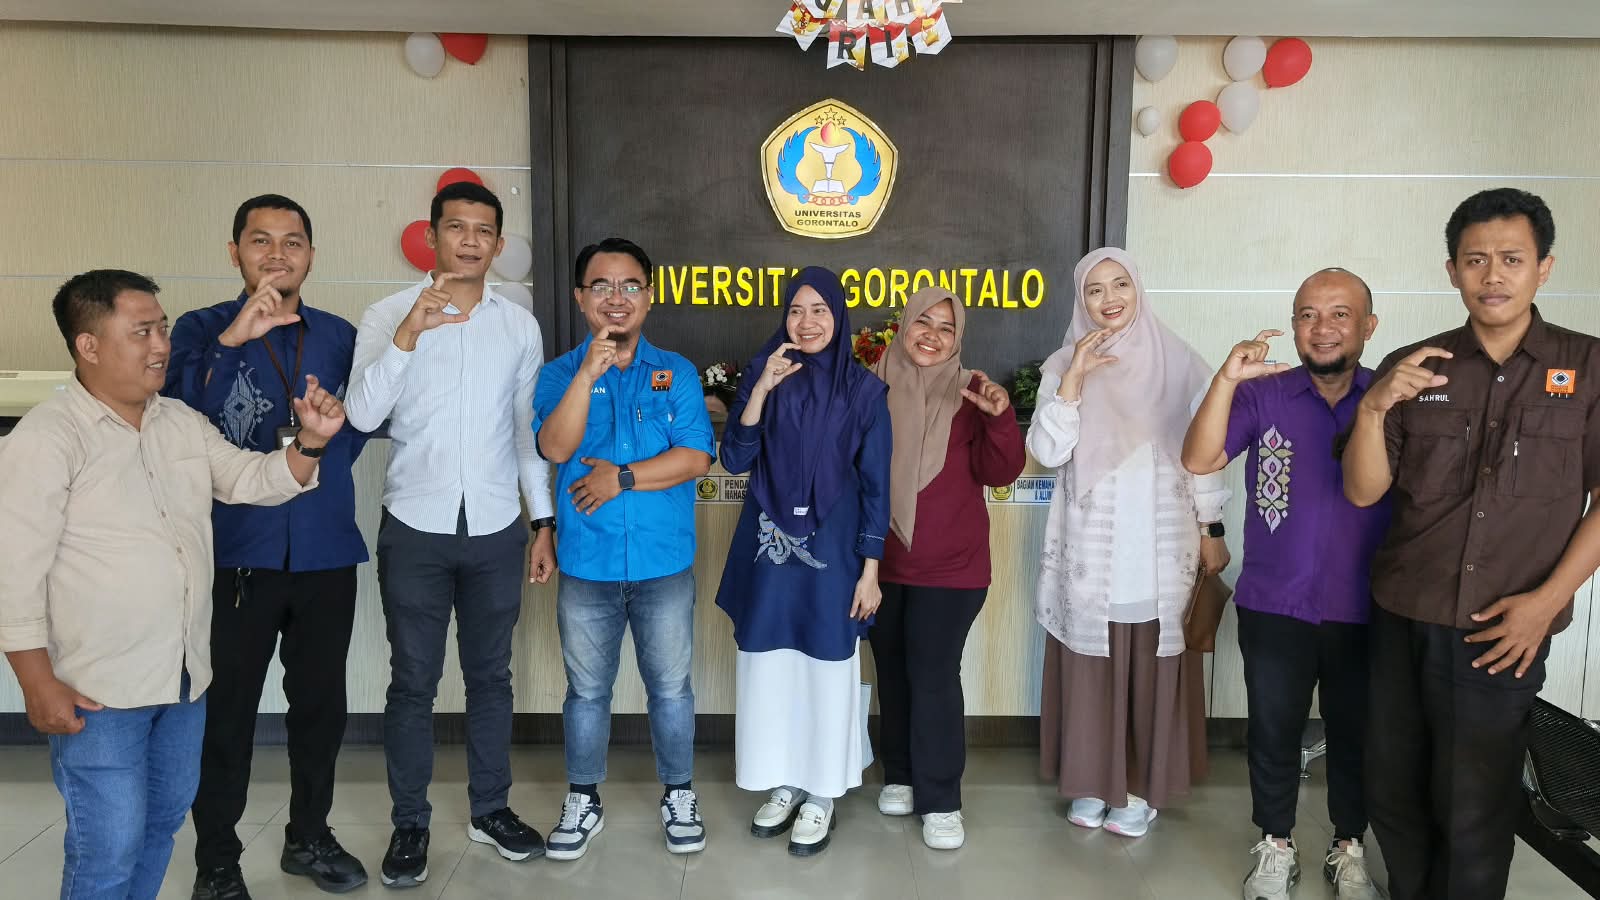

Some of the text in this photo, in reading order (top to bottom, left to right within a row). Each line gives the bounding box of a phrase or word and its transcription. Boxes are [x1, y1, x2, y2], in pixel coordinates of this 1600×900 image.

[795, 210, 862, 218] UNIVERSITAS
[797, 219, 859, 227] GORONTALO
[1418, 394, 1450, 402] SAHRUL
